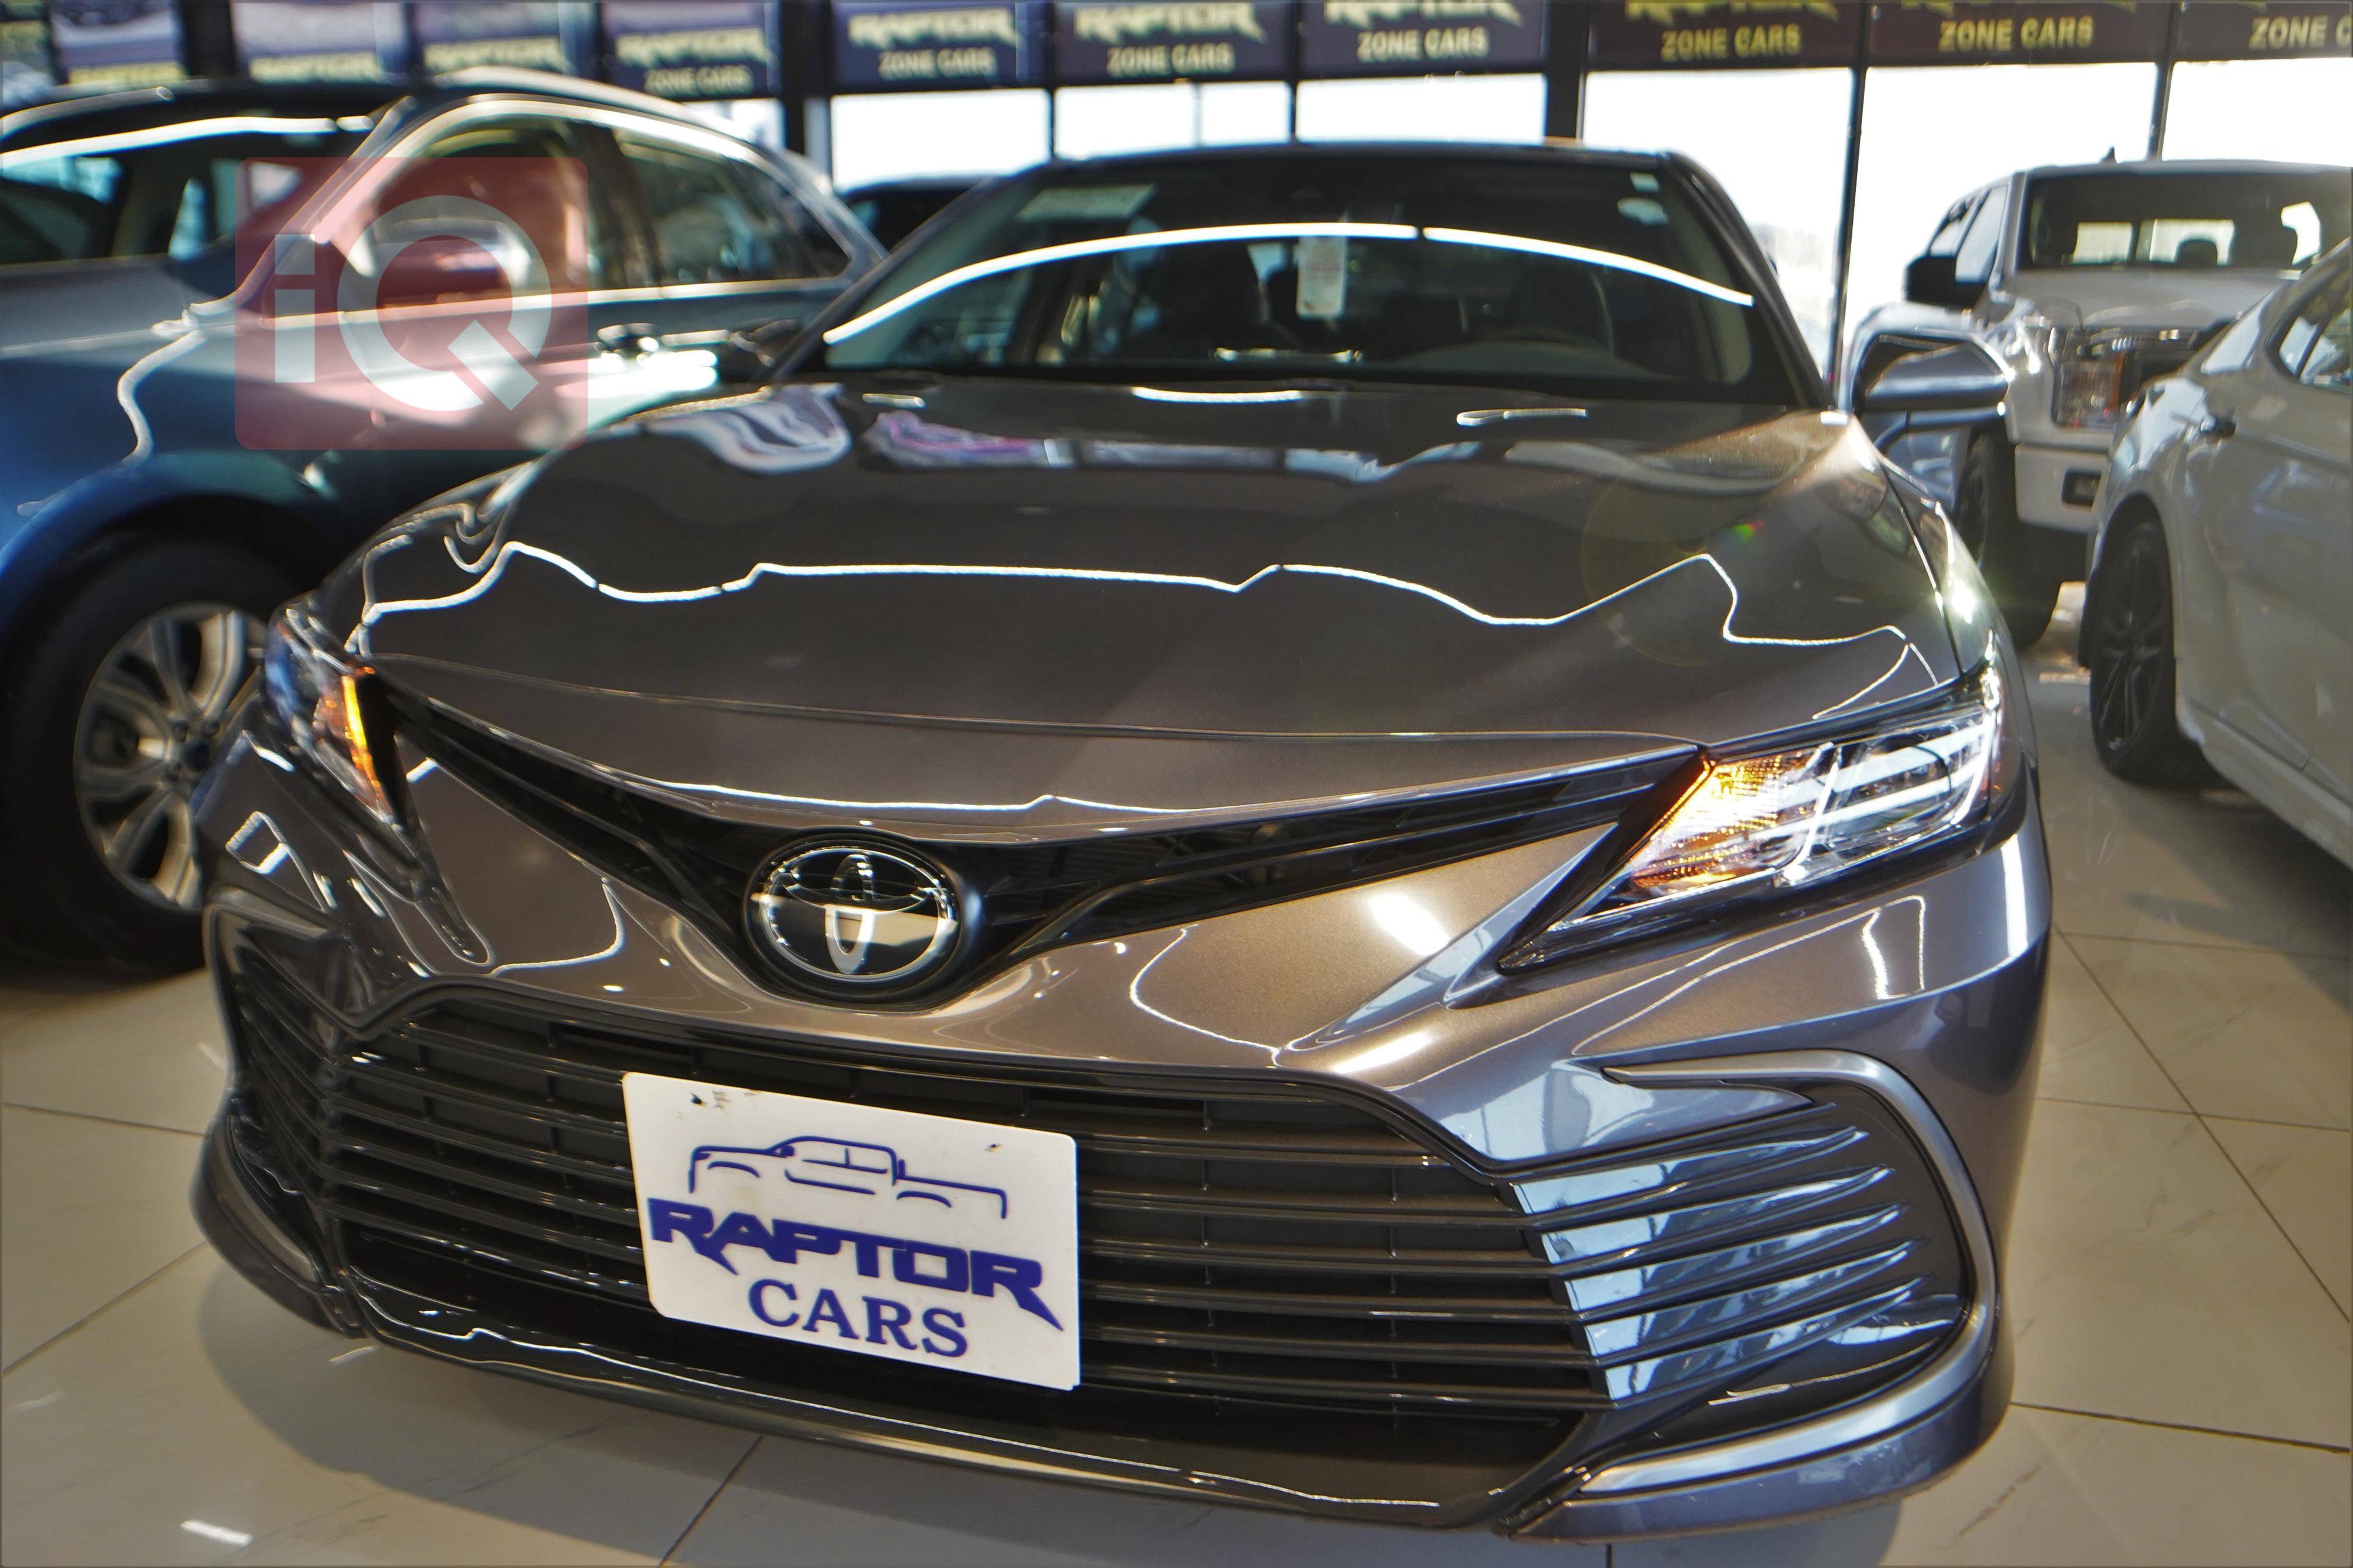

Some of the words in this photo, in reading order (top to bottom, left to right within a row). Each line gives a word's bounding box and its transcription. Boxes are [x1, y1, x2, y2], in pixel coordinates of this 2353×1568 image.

[1357, 30, 1421, 62] ZONE
[1424, 26, 1489, 58] CARS
[1661, 28, 1727, 61] ZONE
[1734, 24, 1802, 57] CARS
[1939, 19, 2012, 52] ZONE
[2020, 15, 2094, 49] CARS
[2249, 15, 2328, 50] ZONE
[878, 49, 936, 81] ZONE
[936, 46, 998, 78] CARS
[1106, 45, 1169, 78] ZONE
[1171, 42, 1235, 75] CARS
[648, 1197, 1063, 1330] RAPTOR
[748, 1279, 968, 1357] CARS
